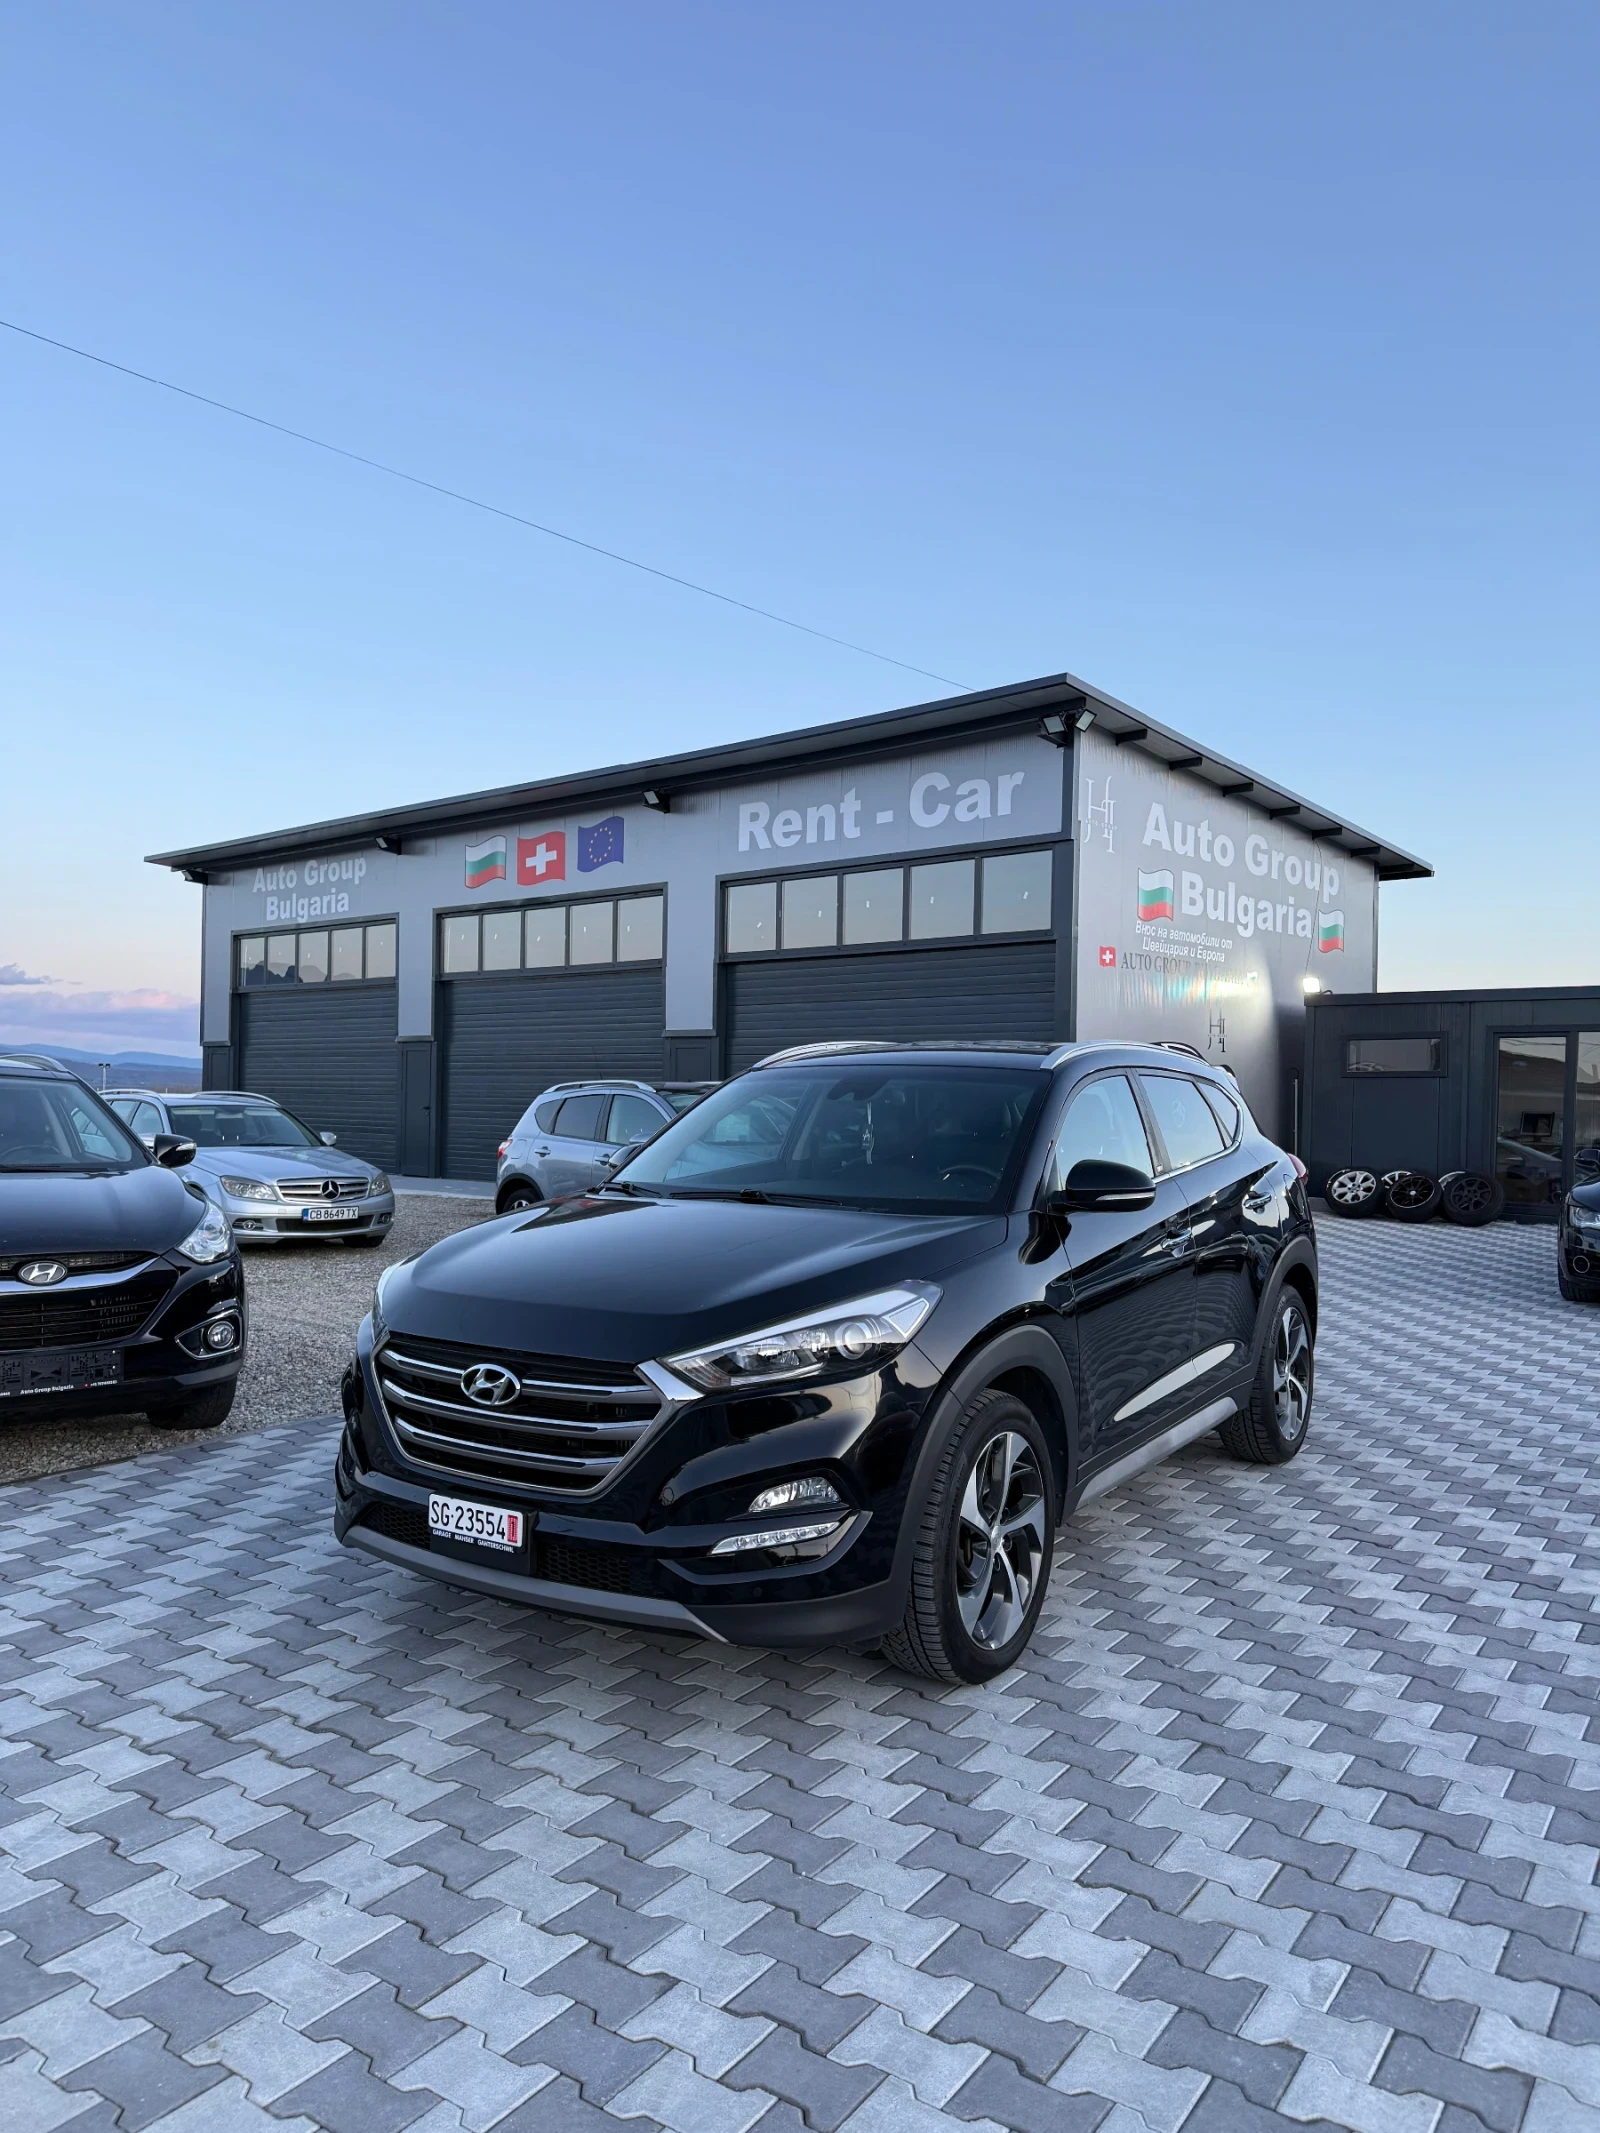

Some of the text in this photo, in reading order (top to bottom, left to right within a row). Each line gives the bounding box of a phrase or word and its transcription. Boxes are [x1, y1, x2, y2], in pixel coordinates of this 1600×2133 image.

[738, 786, 861, 852] Rent
[876, 809, 894, 825] -
[909, 771, 1026, 829] Car
[1142, 801, 1235, 867] Auto
[1244, 834, 1340, 903] Group
[253, 857, 367, 892] Auto Group
[266, 887, 349, 923] Bulgaria
[1181, 870, 1312, 938] Bulgaria
[1135, 920, 1233, 950] Внос на автомобили от
[1121, 951, 1152, 971] AUTO
[1190, 947, 1196, 957] и
[1197, 946, 1225, 963] Европа
[310, 1208, 357, 1220] CB 8649 TX
[432, 1529, 452, 1539] GARAGE
